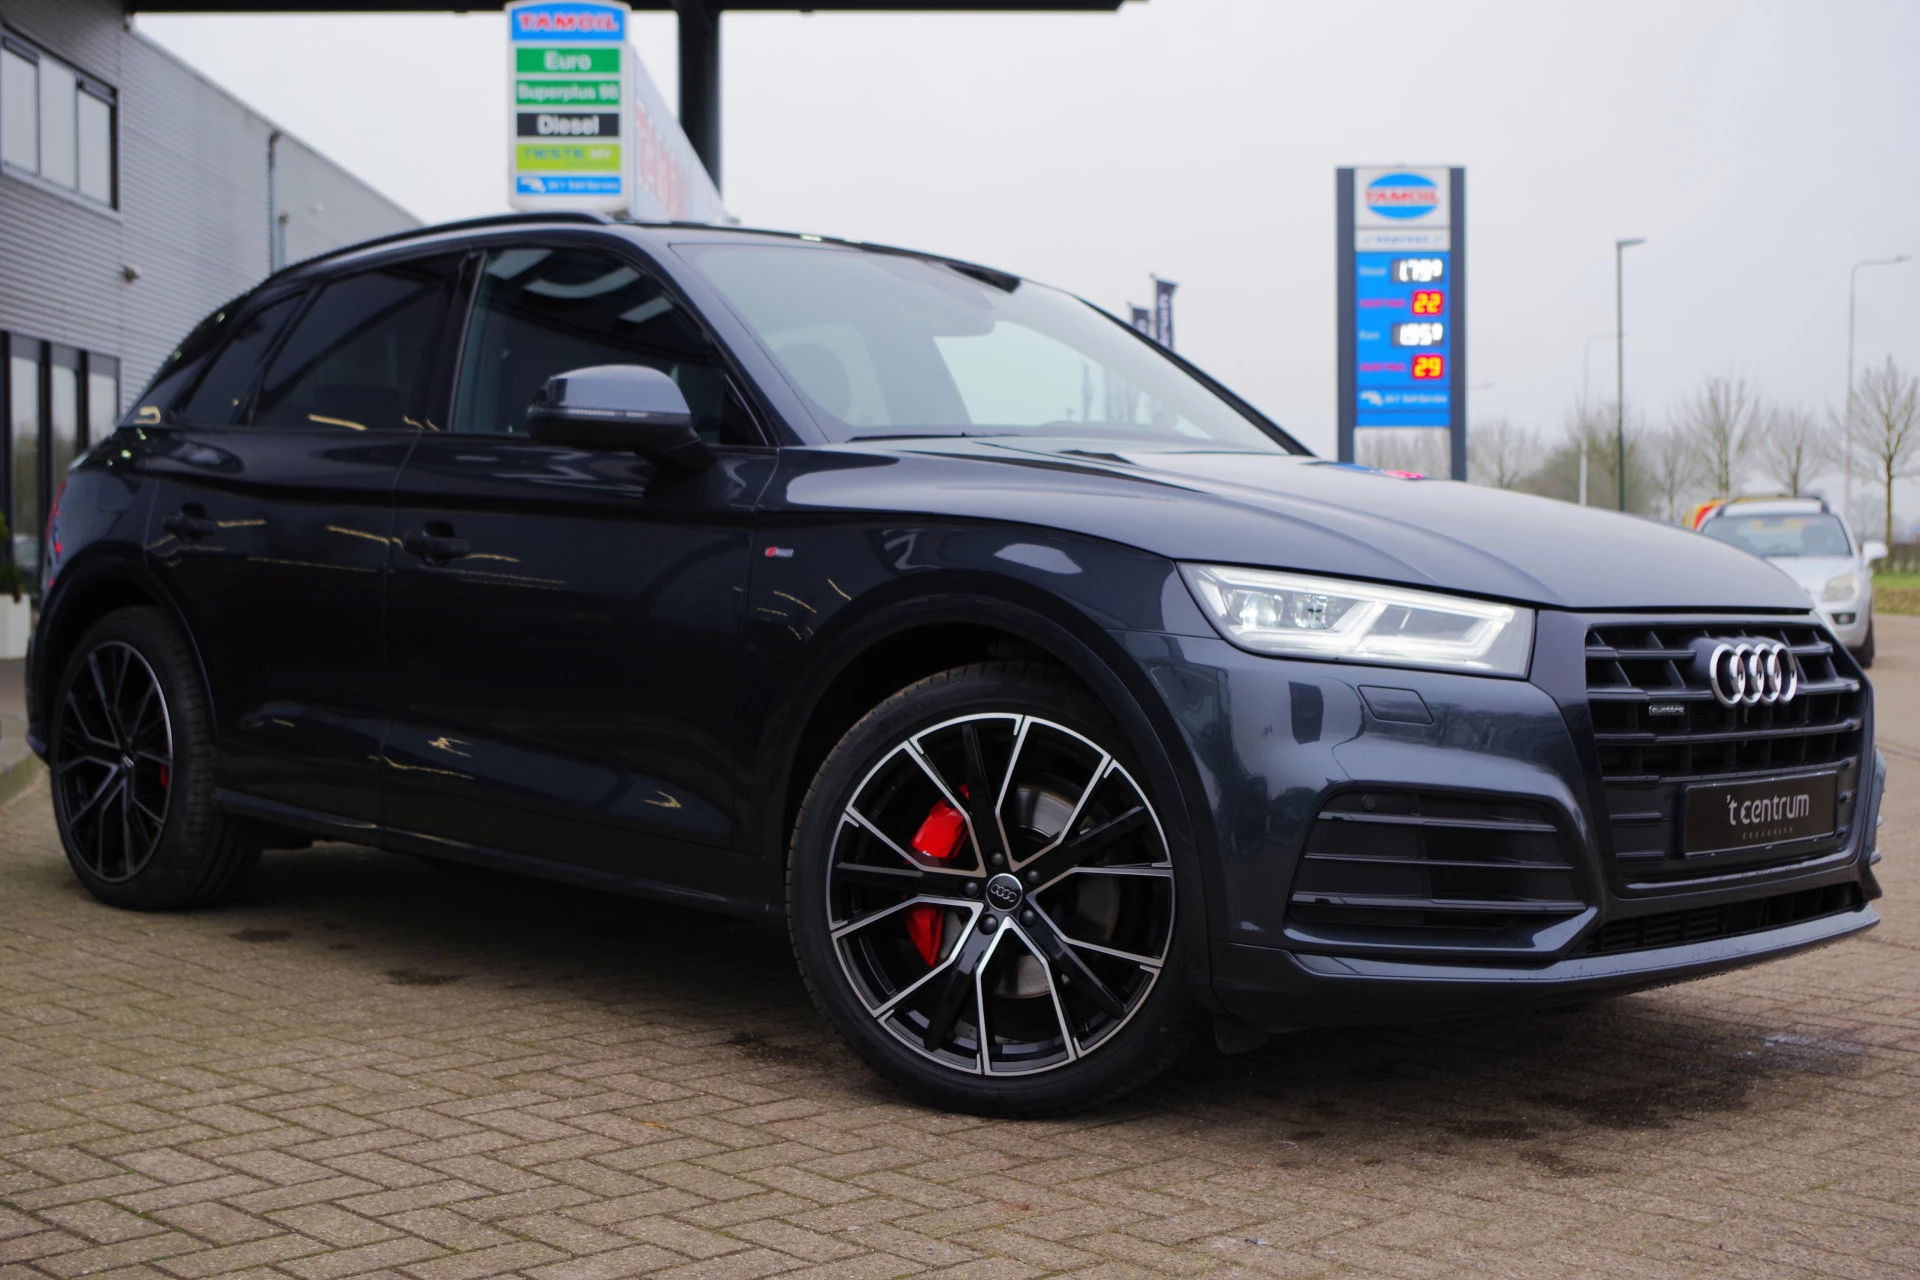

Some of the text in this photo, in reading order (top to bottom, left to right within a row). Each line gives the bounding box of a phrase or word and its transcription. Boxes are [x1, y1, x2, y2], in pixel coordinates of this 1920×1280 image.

[518, 13, 619, 32] TAMOIL
[544, 50, 592, 71] Euro
[517, 83, 597, 102] Superplus
[537, 114, 599, 136] Diesel
[1413, 293, 1442, 313] 22
[1413, 356, 1442, 377] 29
[1726, 794, 1810, 826] 't centrum
